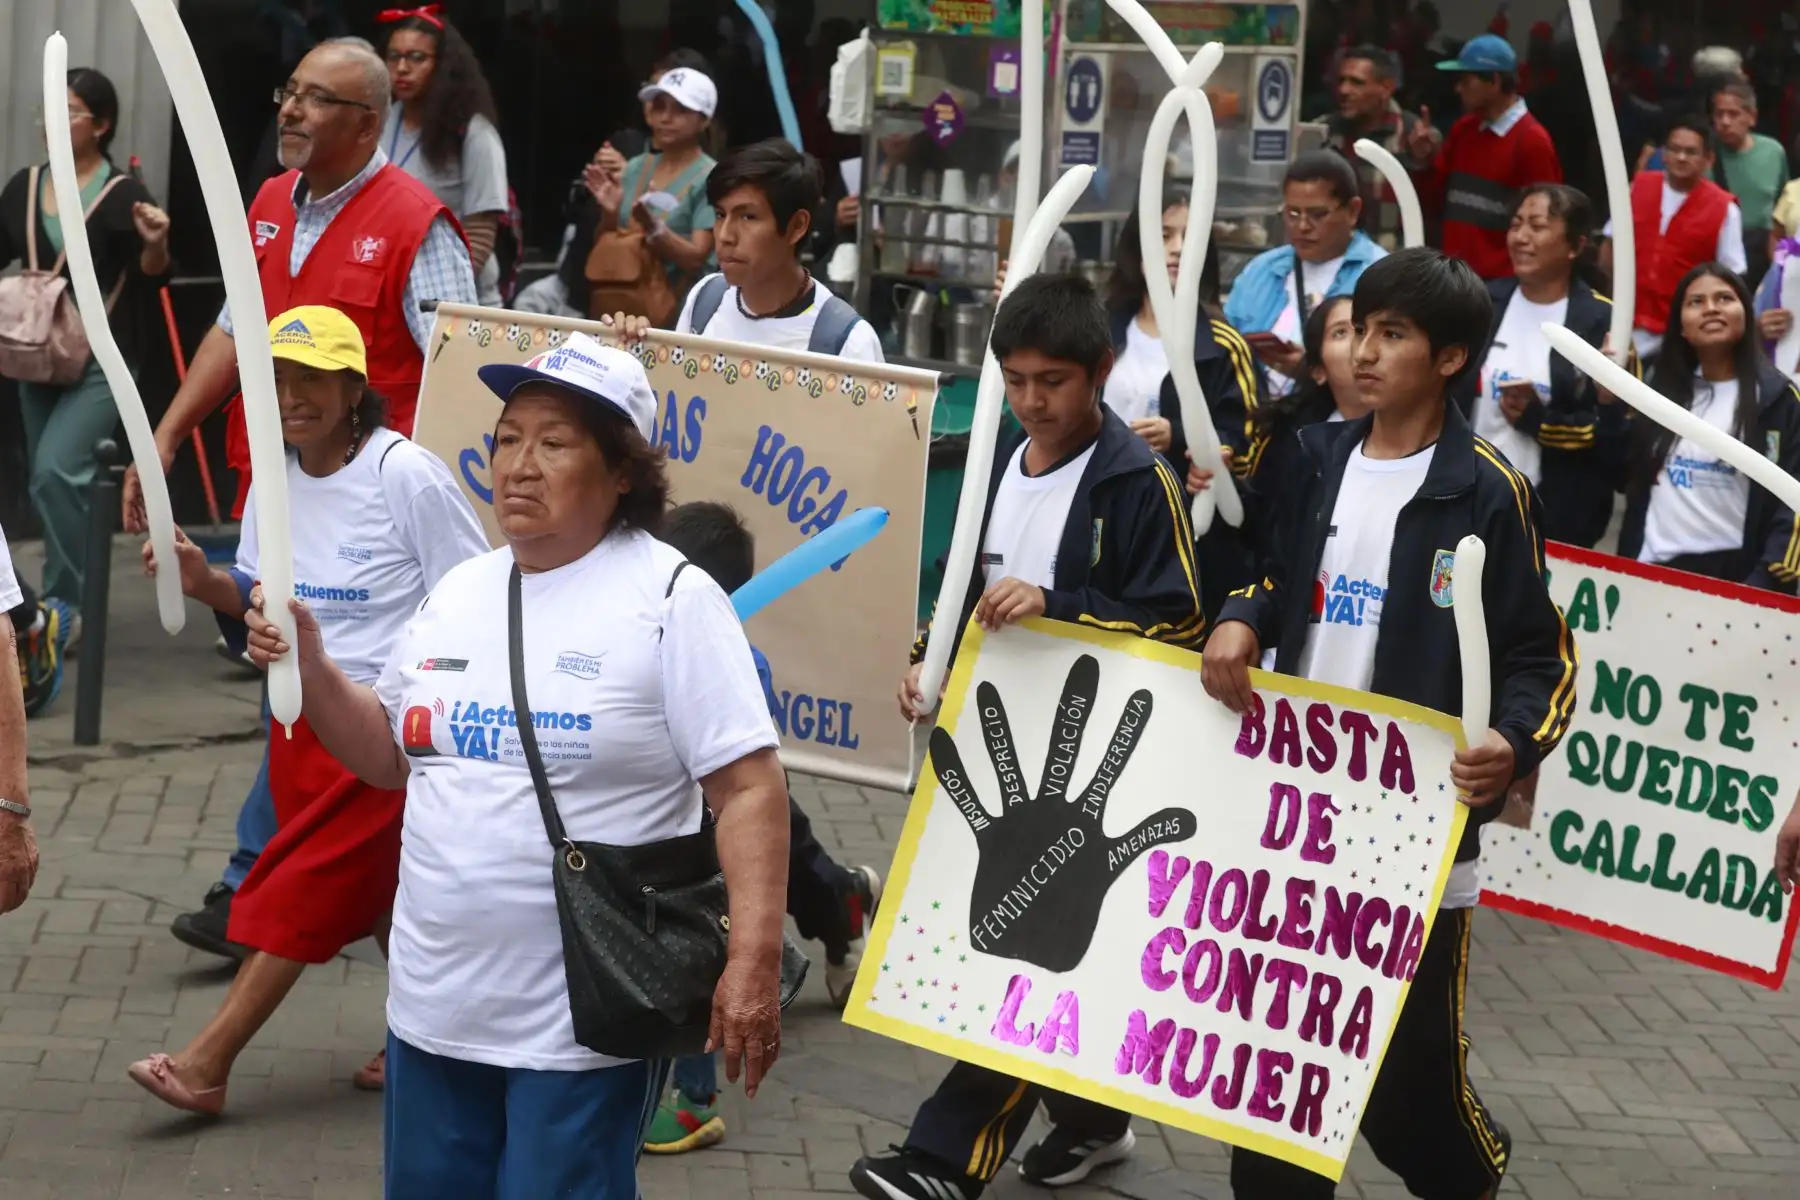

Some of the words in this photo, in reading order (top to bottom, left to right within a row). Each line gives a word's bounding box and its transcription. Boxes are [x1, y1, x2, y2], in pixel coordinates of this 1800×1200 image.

[545, 355, 568, 371] YA!
[741, 424, 864, 573] HOGA
[1324, 592, 1366, 627] YA!
[555, 661, 601, 675] PROBLEMA
[1590, 660, 1662, 726] NO
[1679, 683, 1758, 752] TE
[449, 724, 500, 761] YA!
[550, 740, 562, 749] las
[563, 740, 590, 750] niñas
[561, 752, 592, 761] sexual
[985, 706, 1024, 807] DESPRECIO
[1044, 694, 1087, 796] VIOLACIÓN
[1082, 697, 1147, 820] INDIFERENCIA
[1234, 691, 1416, 794] BASTA
[1567, 731, 1779, 833] QUEDES
[940, 769, 990, 831] INSULTOS
[1108, 817, 1181, 871] AMENAZAS
[1260, 782, 1342, 865] DE
[971, 827, 1085, 949] FEMINICIDIO
[1147, 850, 1426, 983] VIOLENCIA
[1549, 809, 1784, 923] CALLADA
[1141, 927, 1374, 1060] CONTRA
[990, 975, 1080, 1056] LA
[1114, 1009, 1330, 1137] MUJER
